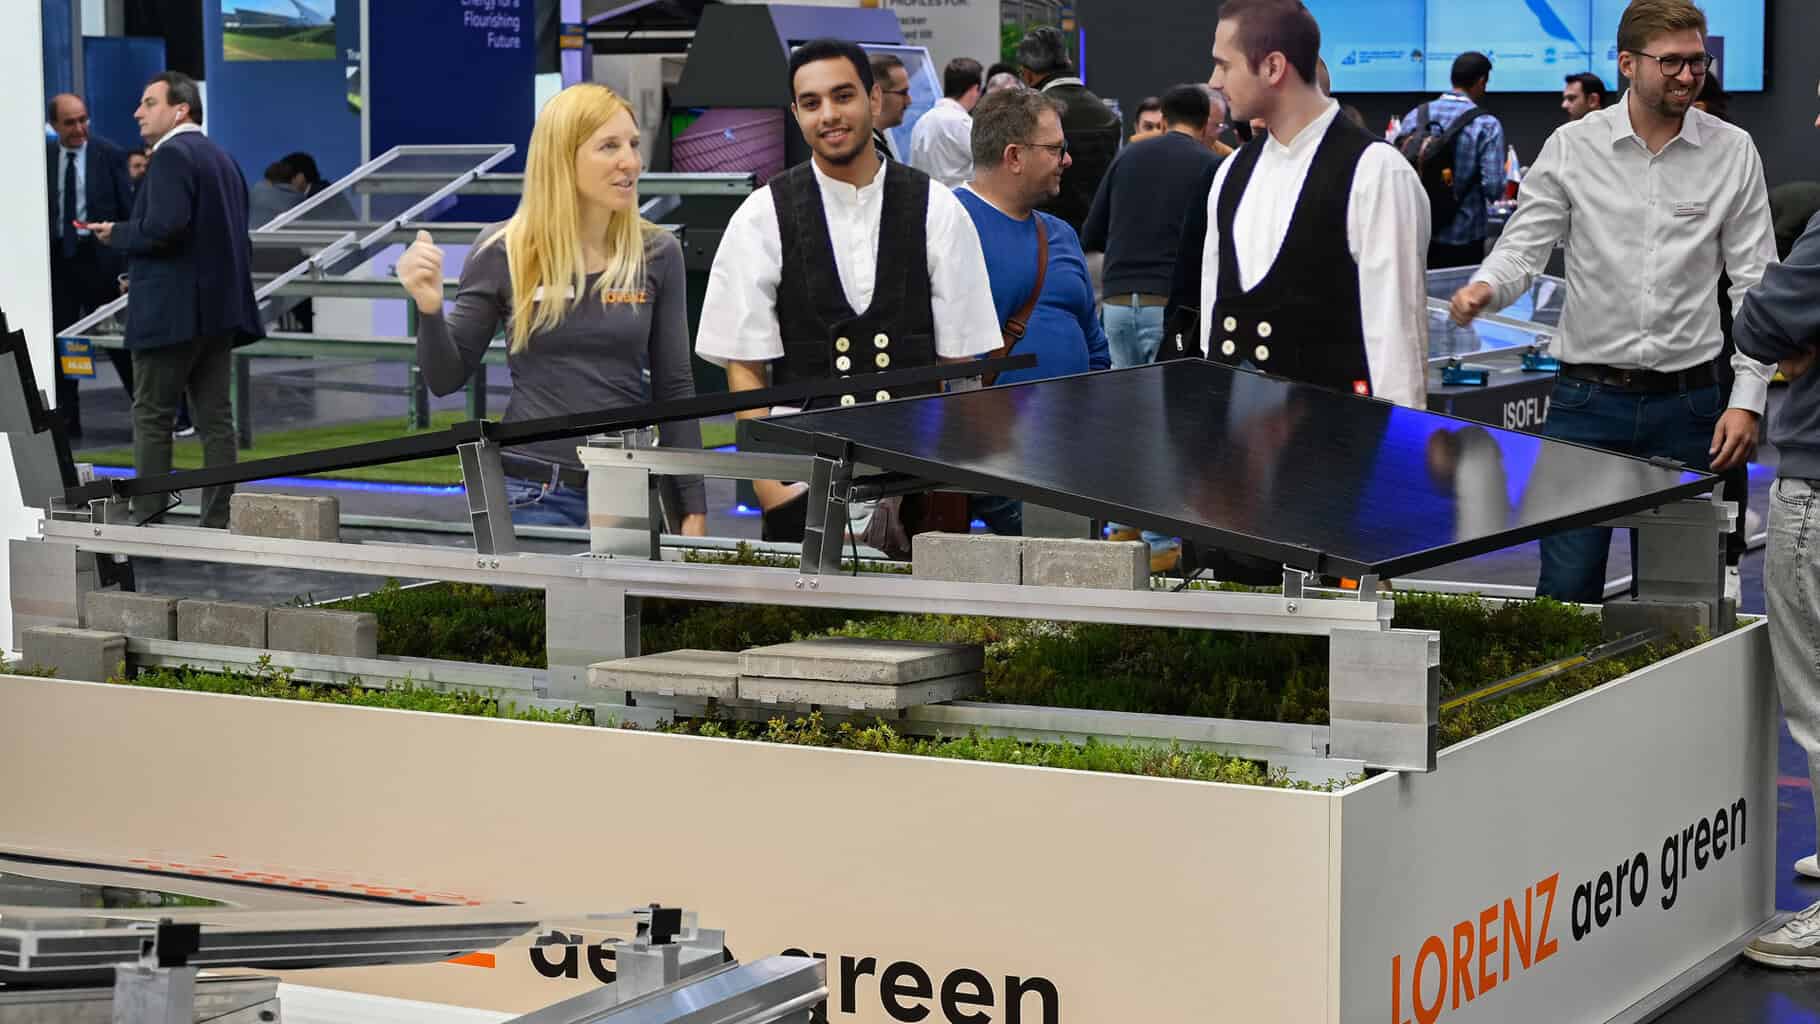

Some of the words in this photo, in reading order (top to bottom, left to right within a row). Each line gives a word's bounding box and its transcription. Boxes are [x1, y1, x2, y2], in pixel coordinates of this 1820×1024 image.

[464, 11, 520, 32] Flourishing
[487, 32, 520, 48] Future
[604, 290, 648, 304] ORENZ
[1391, 872, 1560, 1024] LORENZ
[1571, 852, 1649, 942] aero
[1661, 797, 1747, 910] green
[780, 948, 1060, 1024] reen
